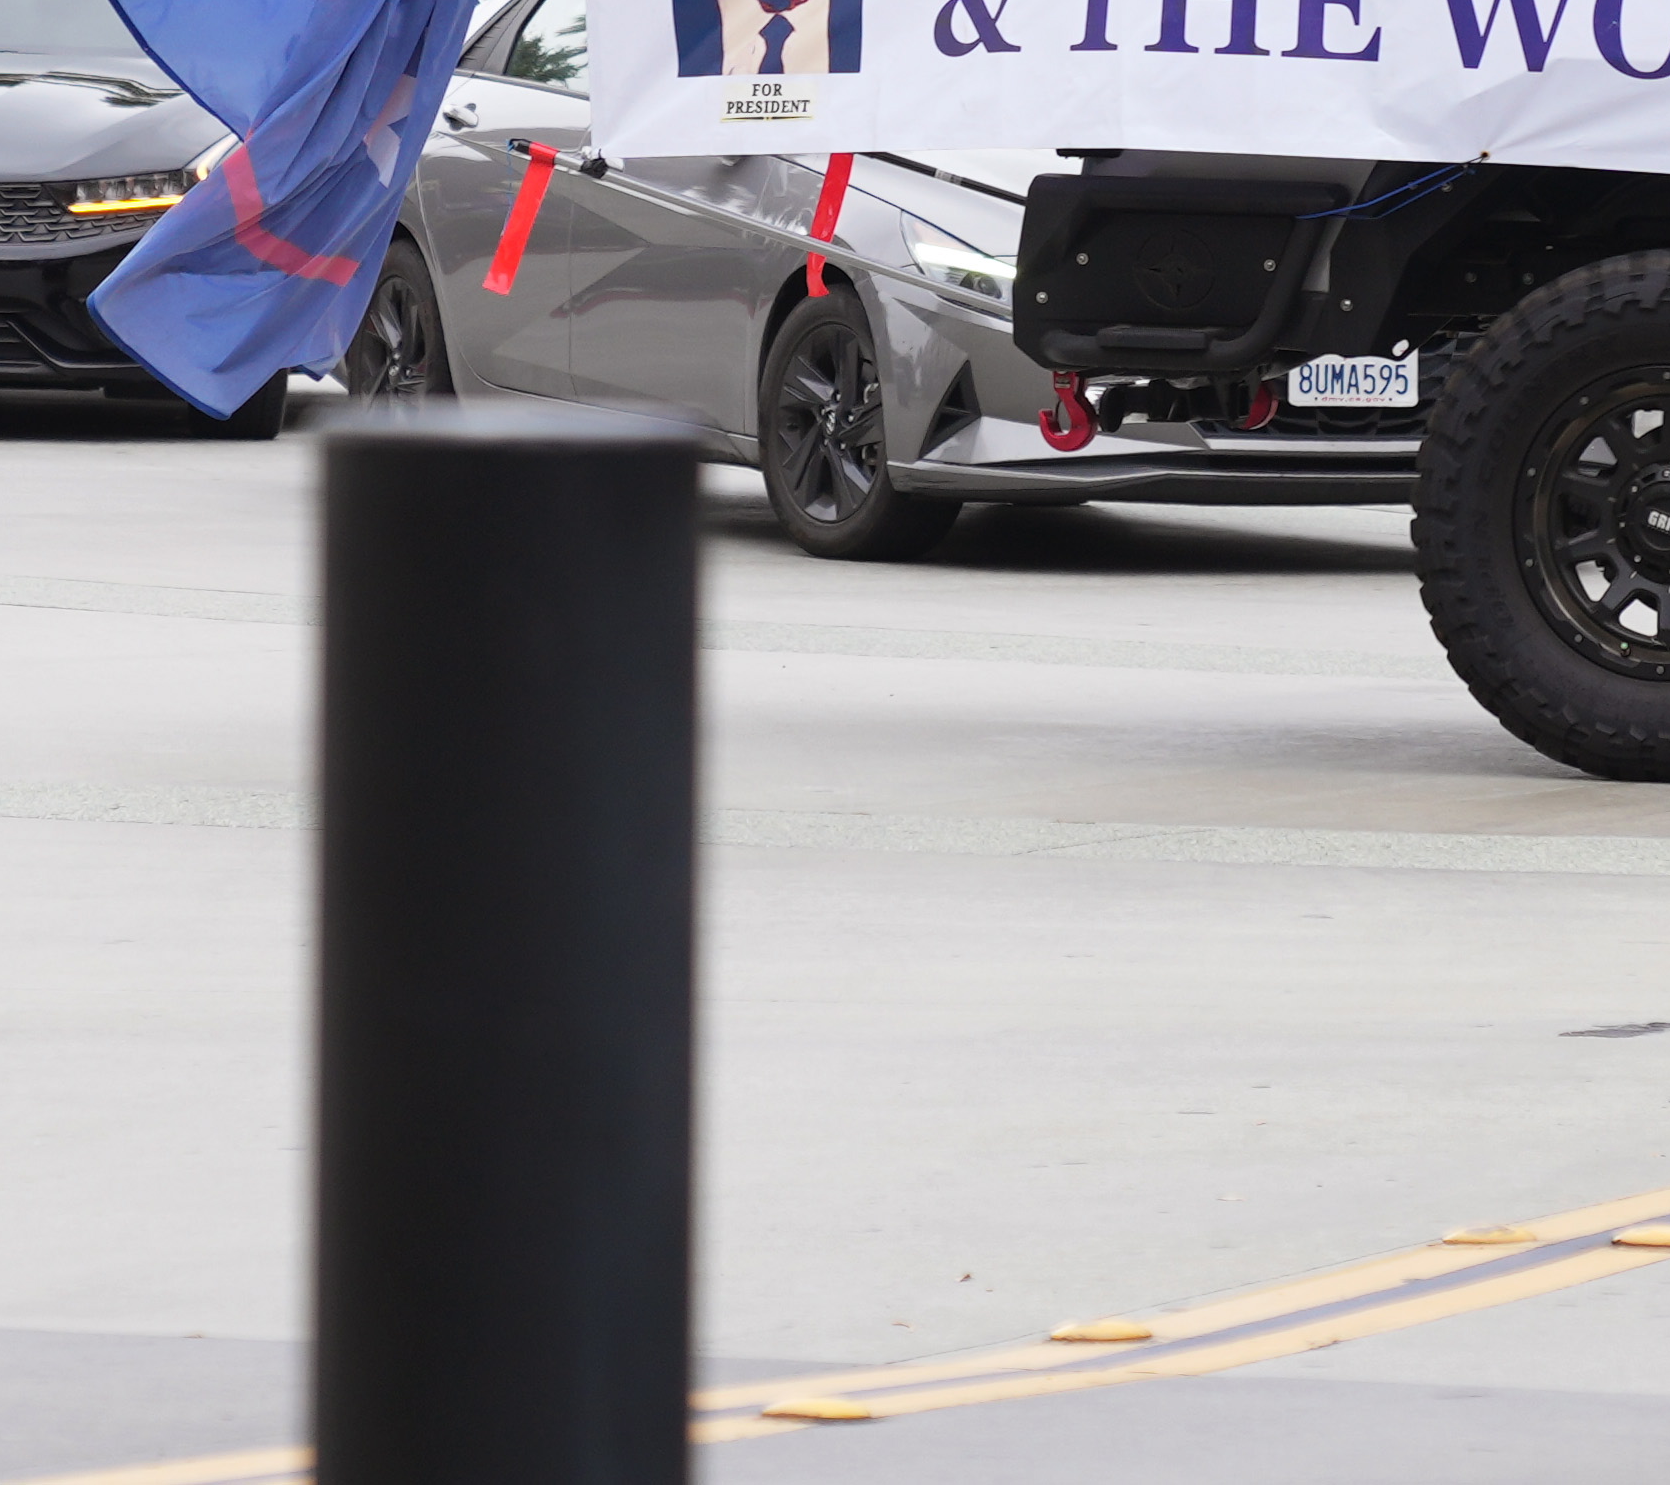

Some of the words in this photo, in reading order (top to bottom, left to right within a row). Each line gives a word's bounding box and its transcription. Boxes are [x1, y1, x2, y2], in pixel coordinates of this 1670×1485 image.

[751, 83, 783, 97] FOR
[725, 99, 811, 115] PRESIDENT
[1298, 363, 1409, 396] 8UMA595
